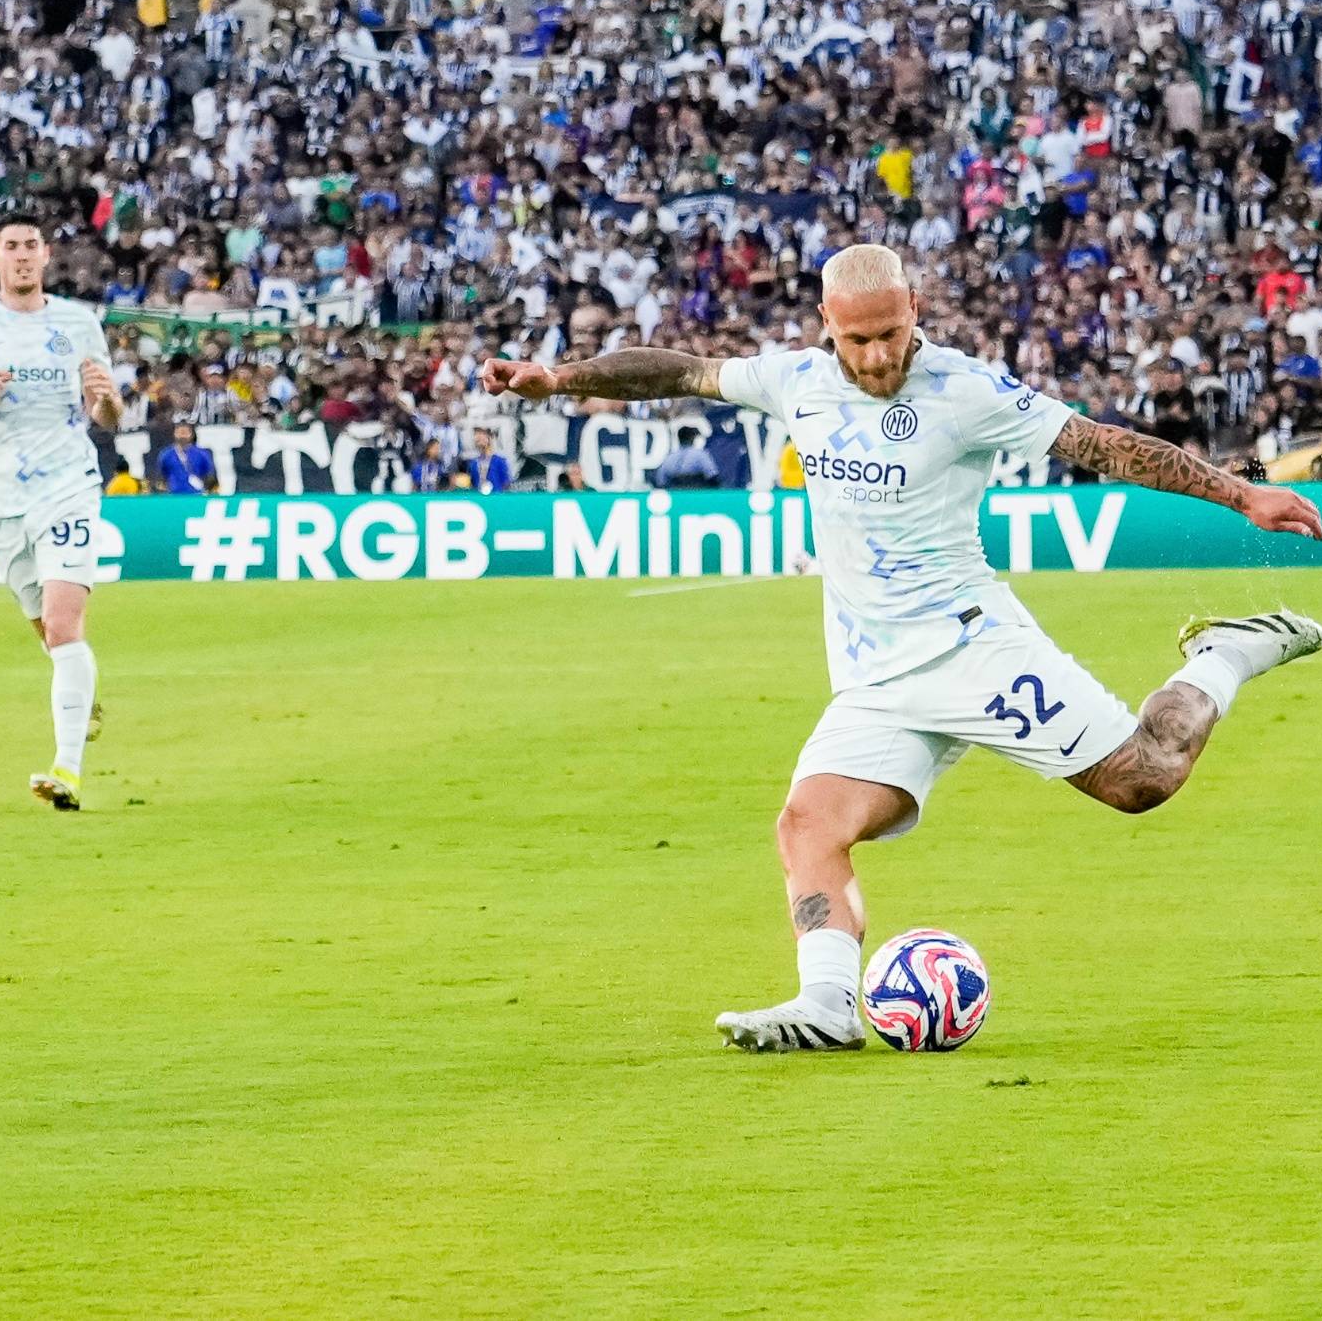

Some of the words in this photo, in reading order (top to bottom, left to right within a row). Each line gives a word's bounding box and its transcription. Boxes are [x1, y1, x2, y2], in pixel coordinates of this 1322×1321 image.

[51, 518, 90, 547] 95
[179, 490, 825, 582] #RGB-MiniL
[988, 492, 1129, 574] TV
[984, 673, 1066, 740] 32
